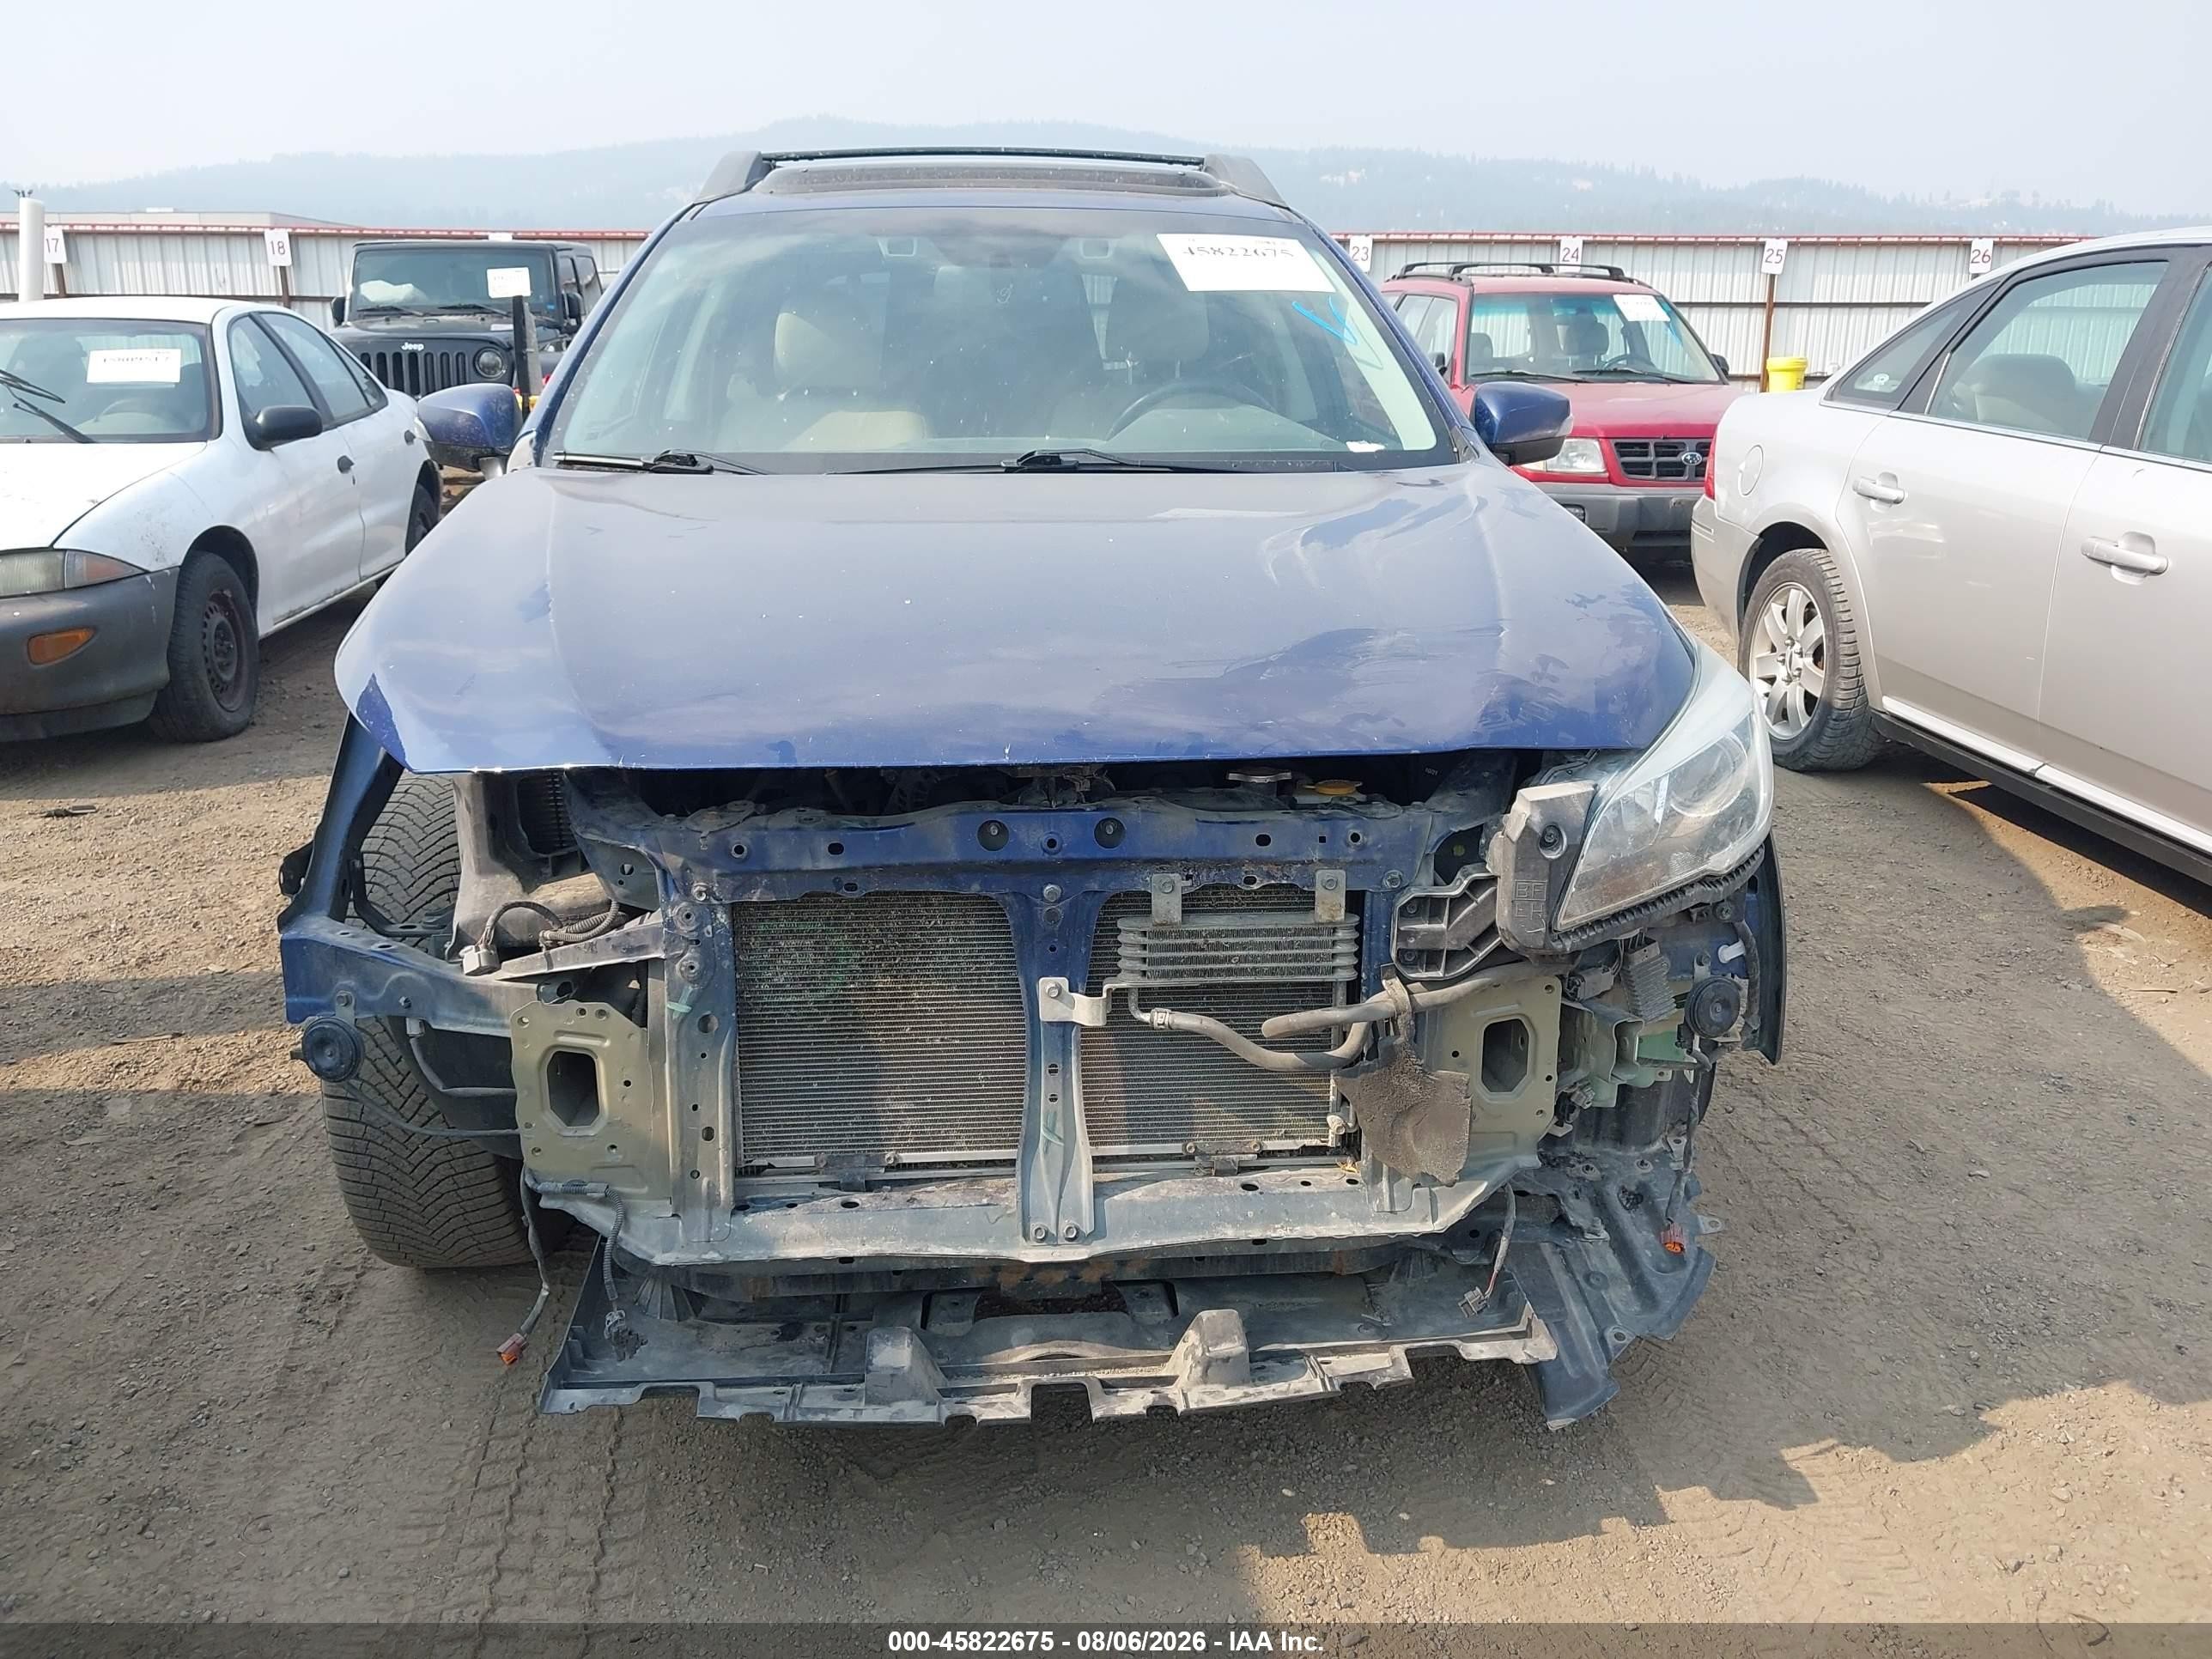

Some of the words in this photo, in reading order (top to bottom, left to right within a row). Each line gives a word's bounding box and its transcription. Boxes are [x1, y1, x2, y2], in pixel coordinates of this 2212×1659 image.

[46, 238, 60, 254] 17
[270, 240, 286, 255] 18
[1352, 246, 1369, 262] 23
[1562, 246, 1579, 262] 24
[1765, 248, 1784, 264] 25
[1971, 248, 1991, 264] 26
[401, 342, 425, 351] Jeep
